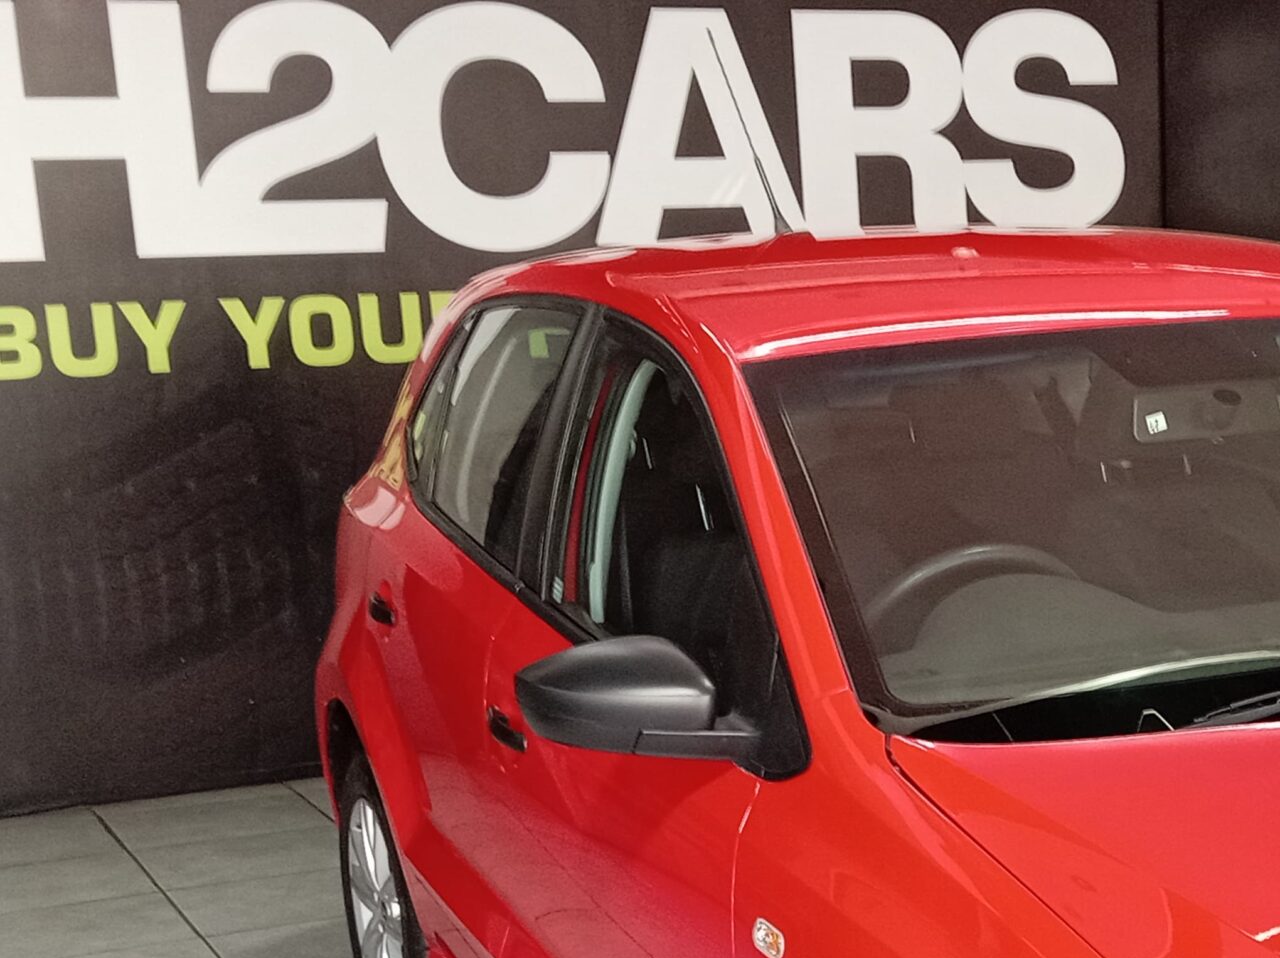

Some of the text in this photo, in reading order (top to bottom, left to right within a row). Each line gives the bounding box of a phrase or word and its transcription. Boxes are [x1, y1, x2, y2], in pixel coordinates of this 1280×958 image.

[0, 0, 1126, 262] H2CARS
[0, 290, 457, 381] BUY YOU
